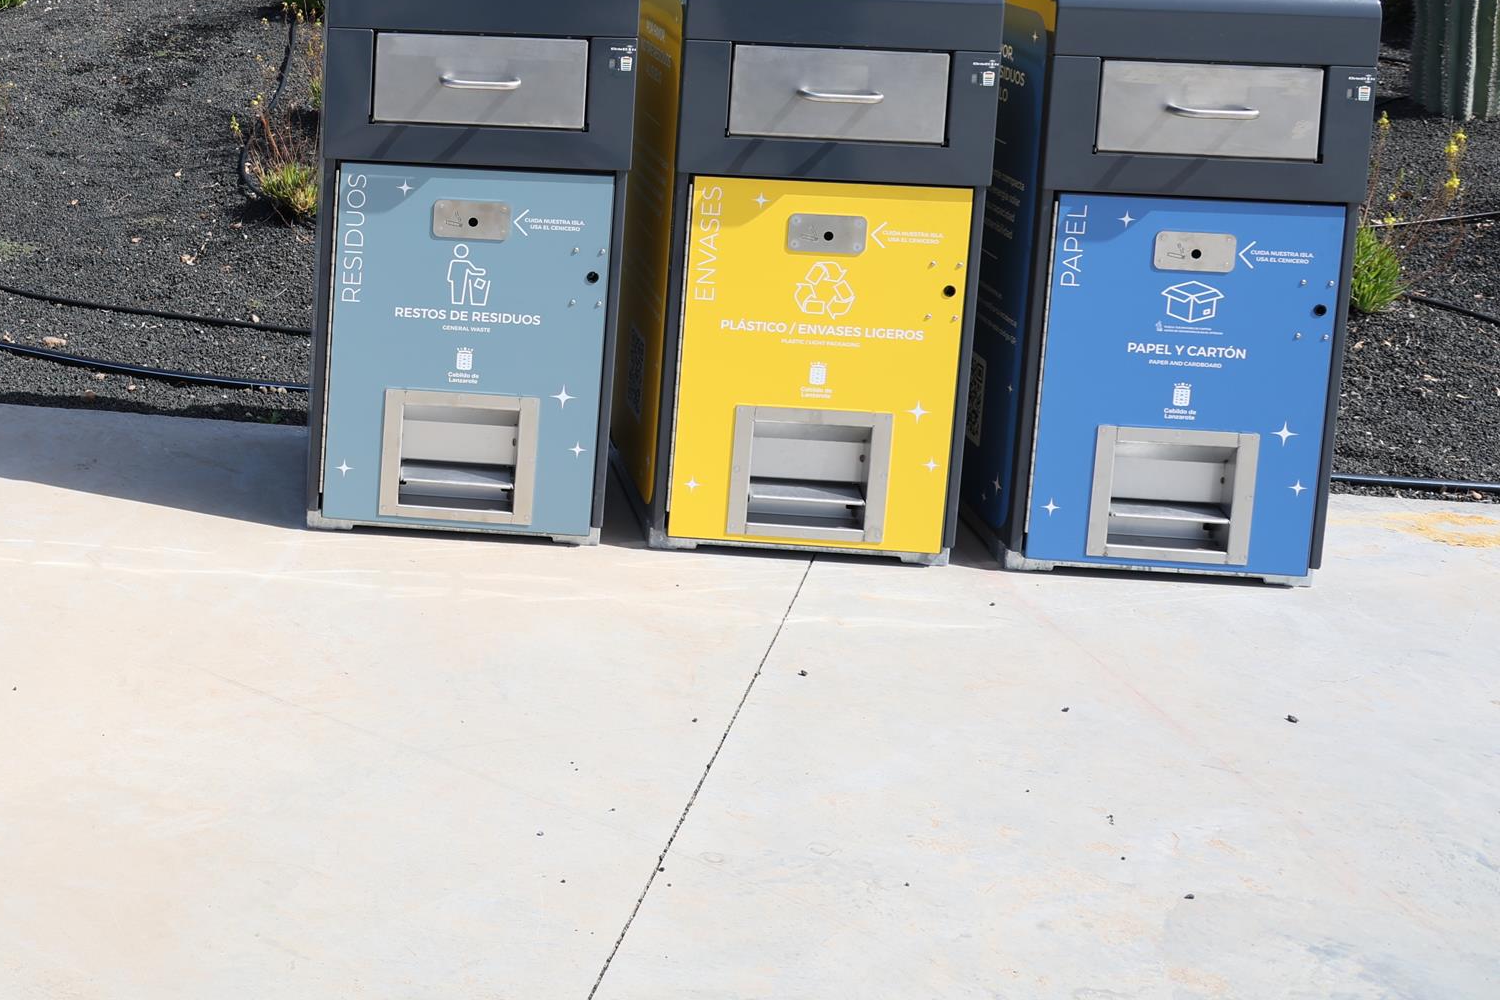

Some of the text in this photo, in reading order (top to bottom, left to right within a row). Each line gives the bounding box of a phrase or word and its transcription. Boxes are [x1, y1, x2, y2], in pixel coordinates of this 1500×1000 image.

[341, 174, 367, 303] RESIDUOS
[694, 185, 724, 301] ENVASES
[1060, 204, 1088, 287] PAPEL
[394, 306, 541, 326] RESTOS DE RESIDUOS
[442, 324, 470, 332] GENERAL
[720, 318, 787, 334] PLÁSTICO
[798, 323, 862, 338] ENVASES
[865, 327, 924, 342] LIGEROS
[1127, 342, 1247, 359] PAPEL Y CARTÓN
[1183, 361, 1222, 369] CARDBOARD
[447, 371, 471, 379] Cabildo
[1163, 407, 1188, 415] Cabildo
[1163, 413, 1196, 421] Lanzarote
